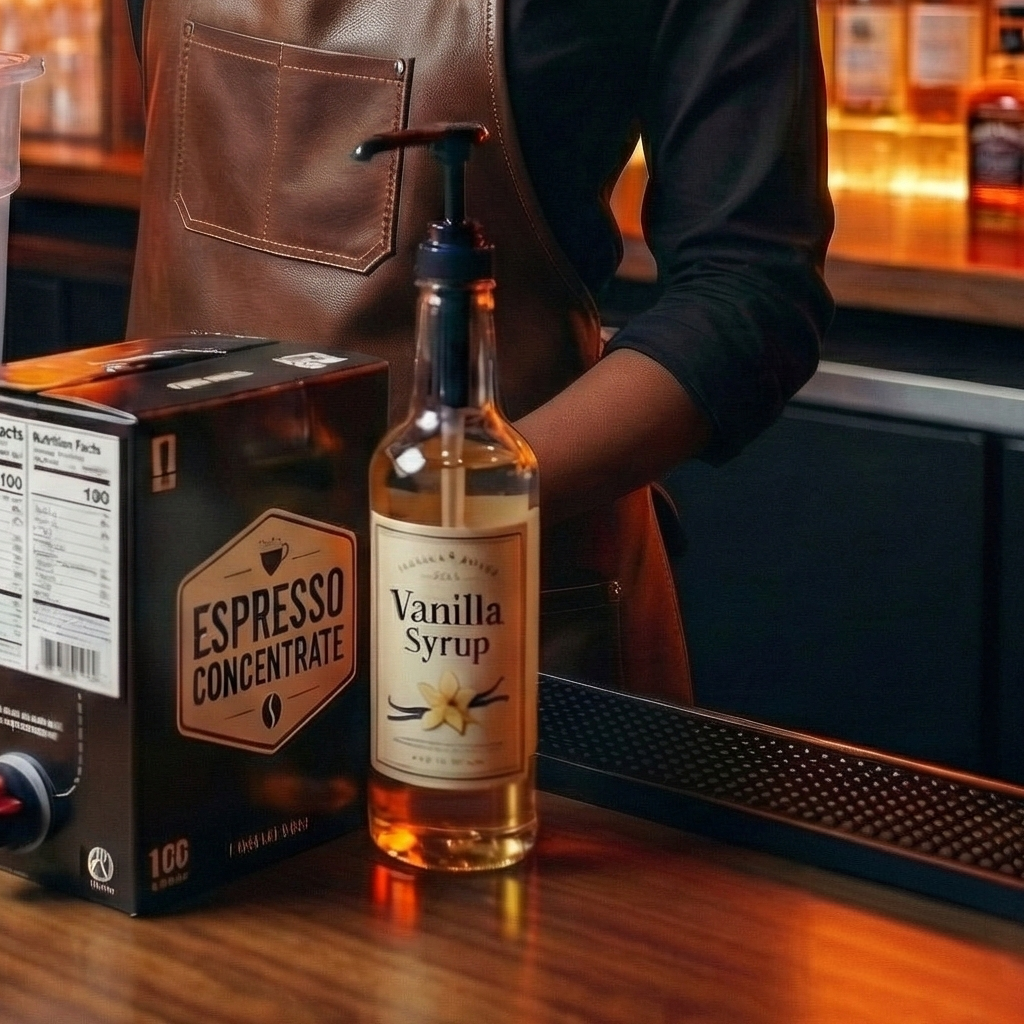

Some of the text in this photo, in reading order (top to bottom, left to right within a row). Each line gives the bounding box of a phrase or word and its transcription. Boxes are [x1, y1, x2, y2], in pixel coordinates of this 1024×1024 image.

[0, 473, 23, 490] 100
[83, 487, 110, 505] 100
[193, 567, 344, 661] ESPRESSO
[390, 589, 504, 626] Vanilla
[404, 627, 490, 665] Syrup
[193, 624, 344, 706] CONCENTRATE
